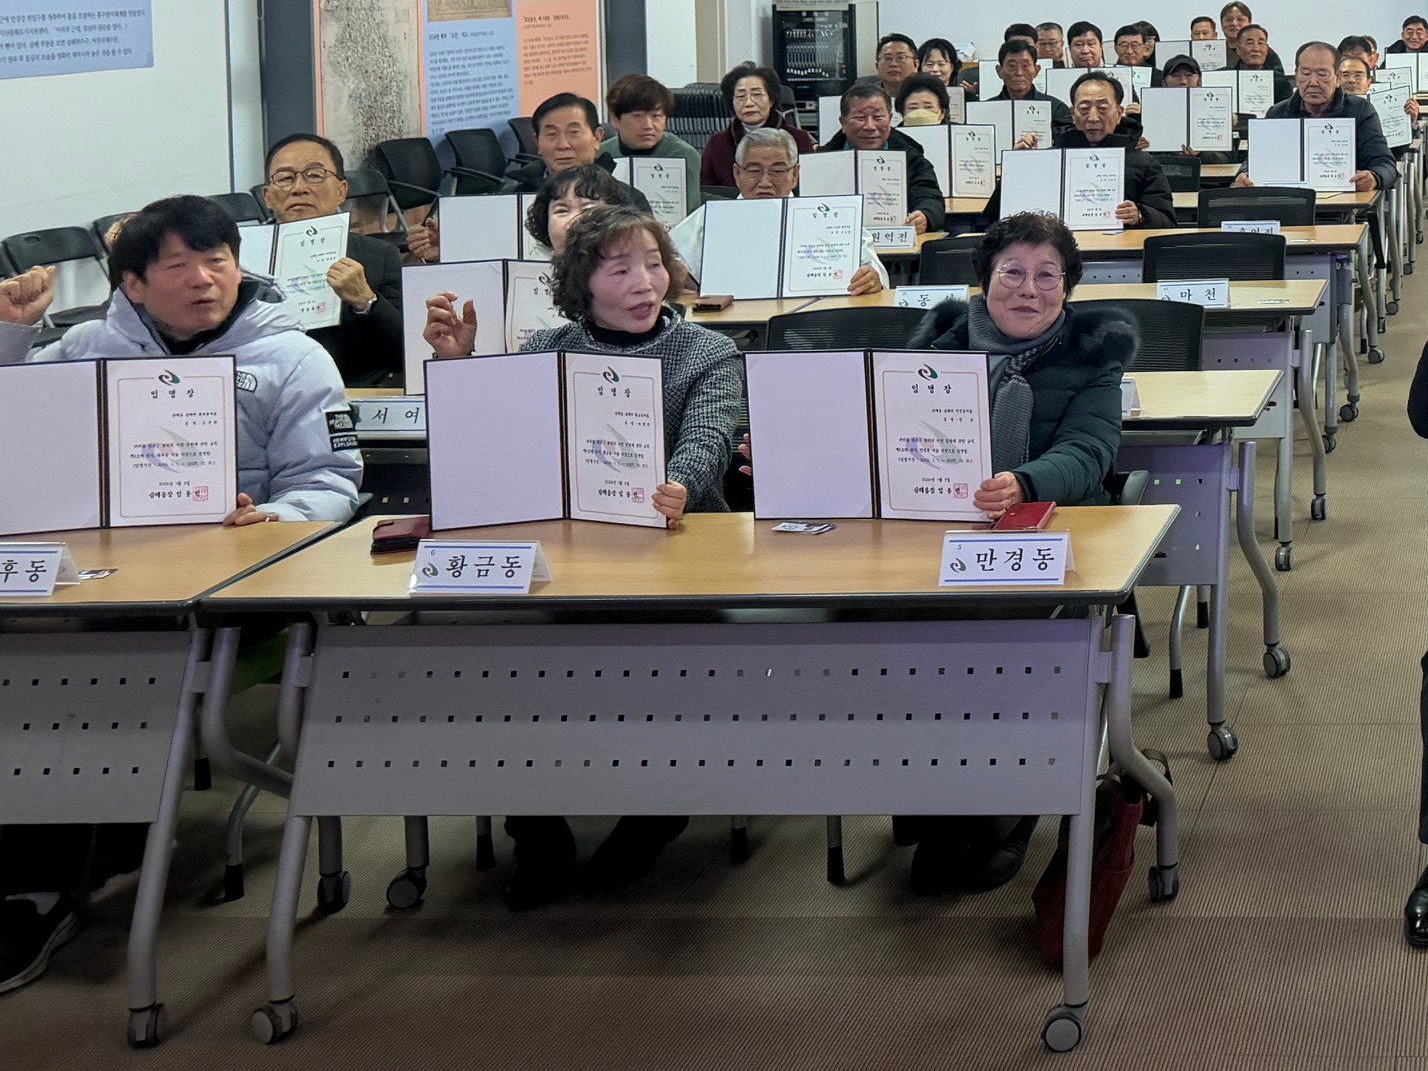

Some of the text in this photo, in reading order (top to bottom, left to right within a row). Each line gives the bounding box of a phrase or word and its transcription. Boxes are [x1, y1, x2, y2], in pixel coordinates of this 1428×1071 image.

[1180, 288, 1216, 301] 마천
[371, 407, 420, 425] 서여
[446, 554, 522, 578] 황금동
[976, 547, 1055, 572] 만경동
